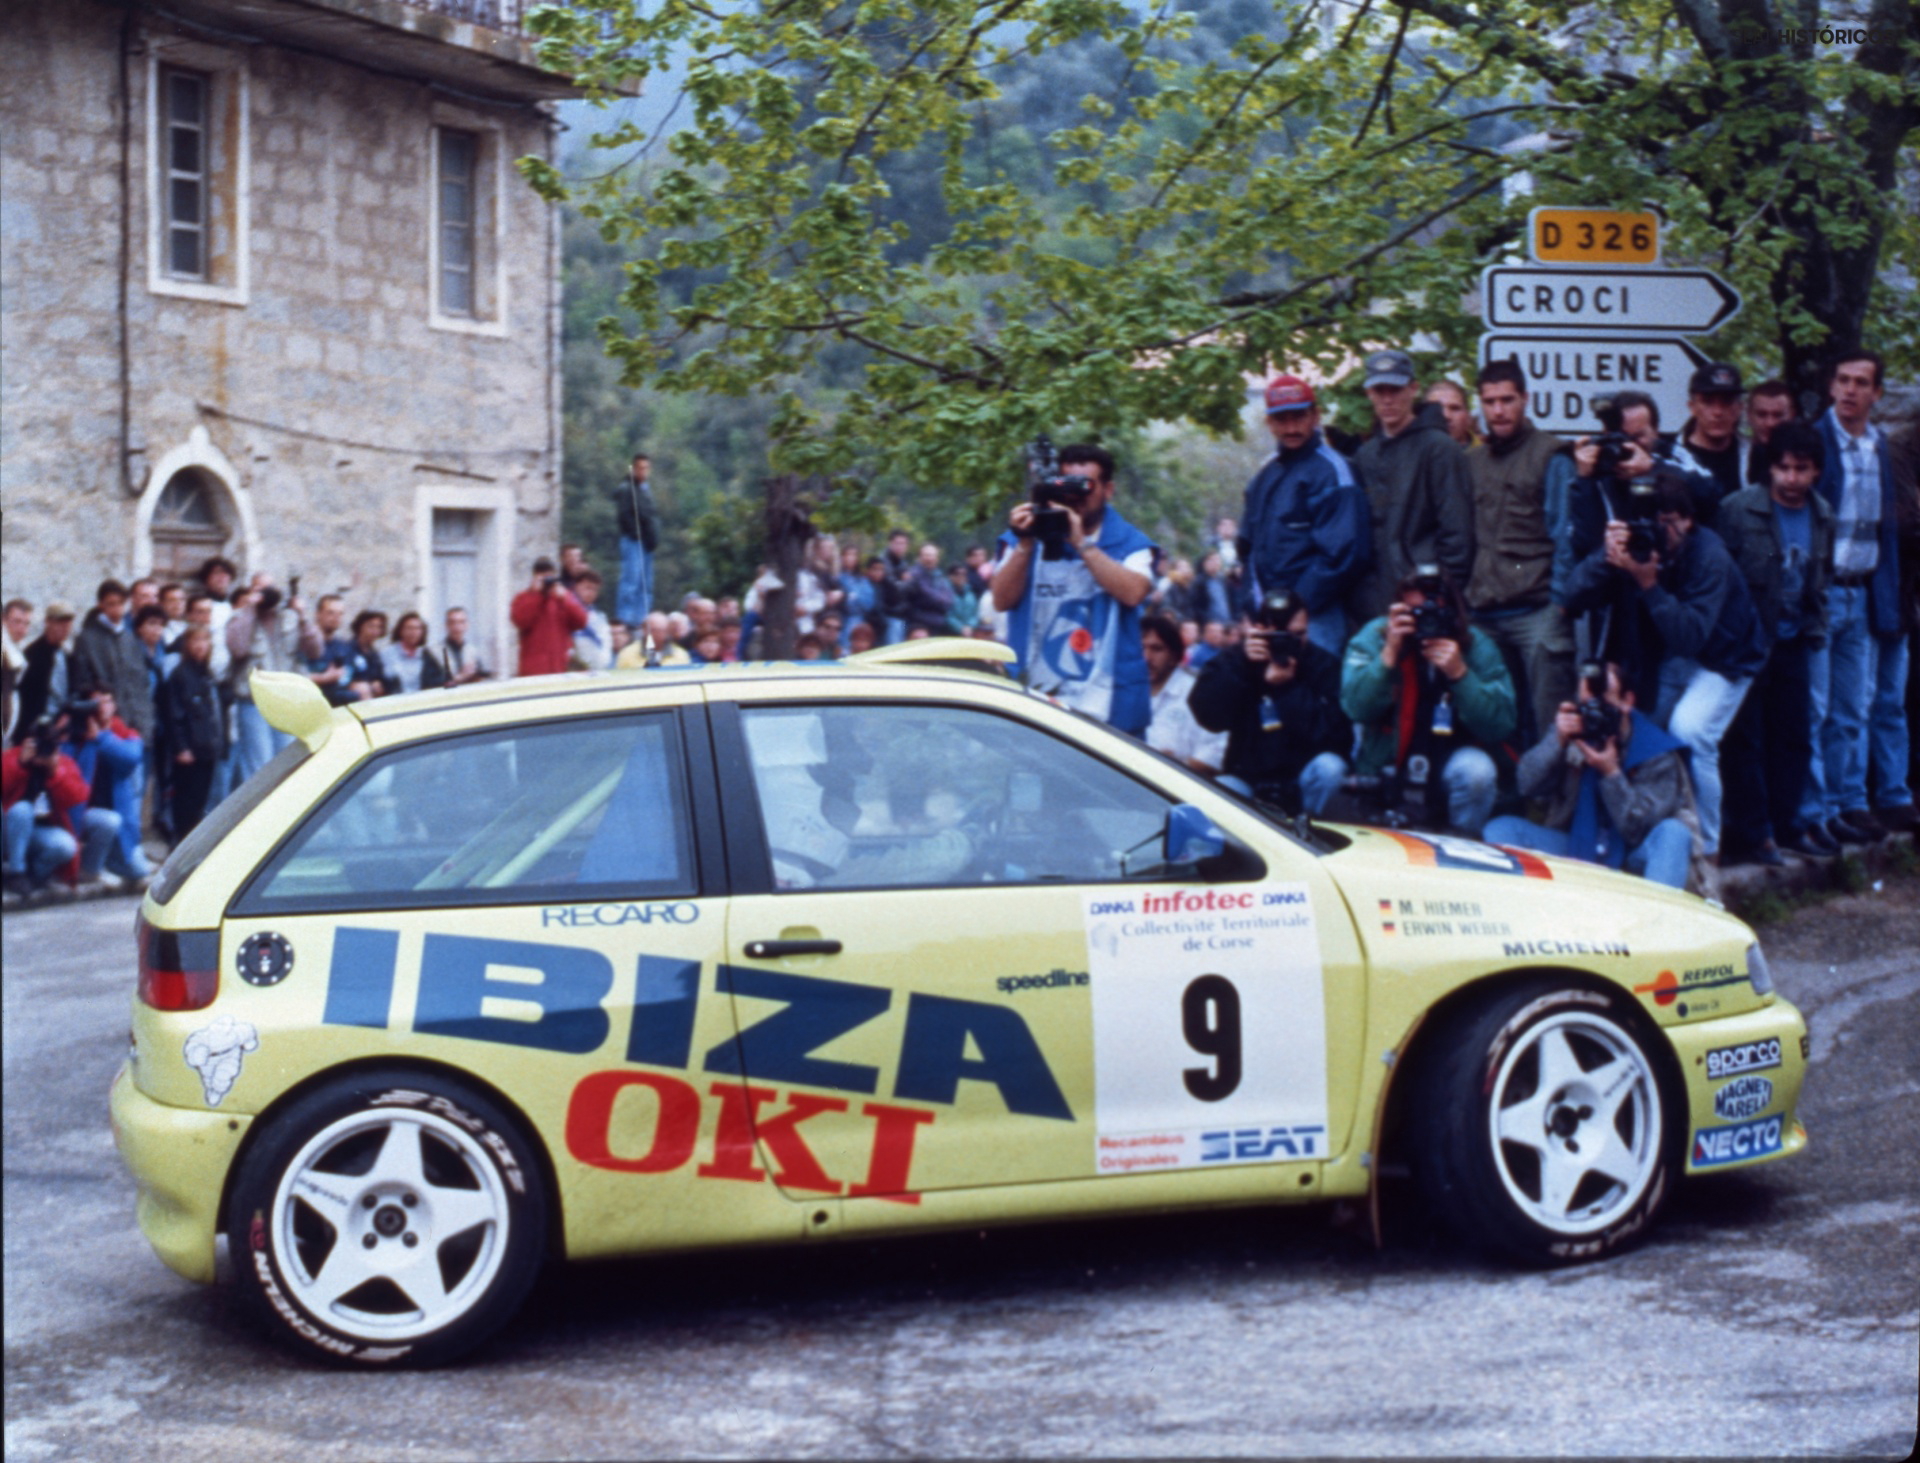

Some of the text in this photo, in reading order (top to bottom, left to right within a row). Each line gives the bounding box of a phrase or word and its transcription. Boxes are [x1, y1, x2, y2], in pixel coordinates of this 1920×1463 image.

[1542, 222, 1651, 251] D 326
[1506, 285, 1629, 314] CROCI
[543, 902, 700, 928] RECARO
[1090, 889, 1306, 915] DANKA infotec DANKA
[1424, 902, 1482, 917] HIEMER
[1121, 914, 1310, 937] Collectivité Territoriale
[1403, 922, 1512, 936] ERWIN WEBER
[1183, 936, 1255, 951] de Corse
[1502, 940, 1631, 958] MICHELIN
[996, 969, 1090, 993] speedline
[322, 925, 1077, 1122] IBIZA
[1181, 973, 1243, 1102] 9
[1707, 1040, 1780, 1076] sparco
[565, 1069, 935, 1206] OKI
[1201, 1125, 1324, 1161] SEAT
